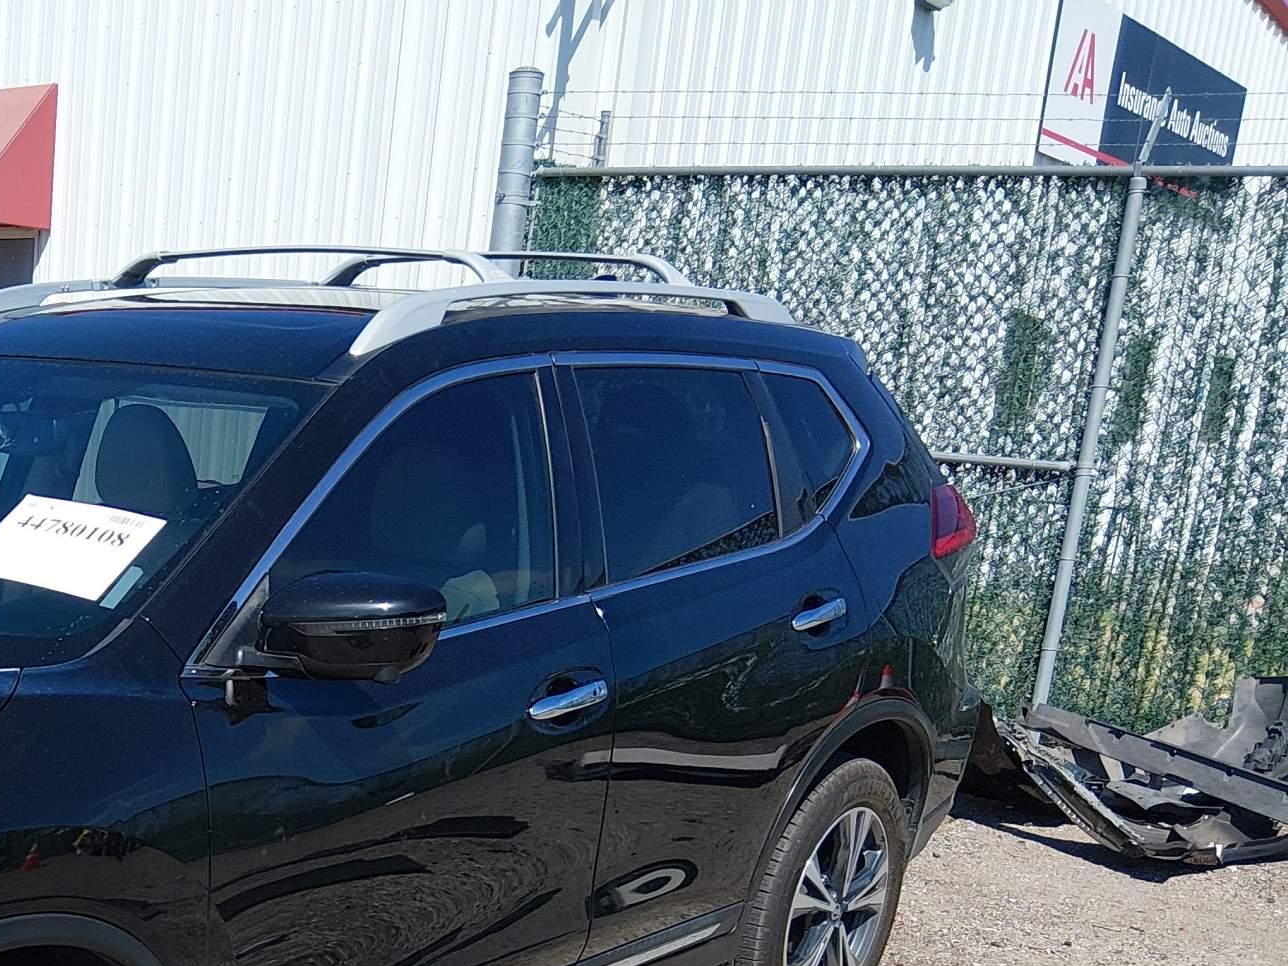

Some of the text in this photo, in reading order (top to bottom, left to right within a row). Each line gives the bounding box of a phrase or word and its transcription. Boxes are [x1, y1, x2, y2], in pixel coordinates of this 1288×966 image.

[1167, 98, 1190, 139] Auto
[1190, 110, 1230, 158] Auctions
[17, 514, 130, 547] 44780108
